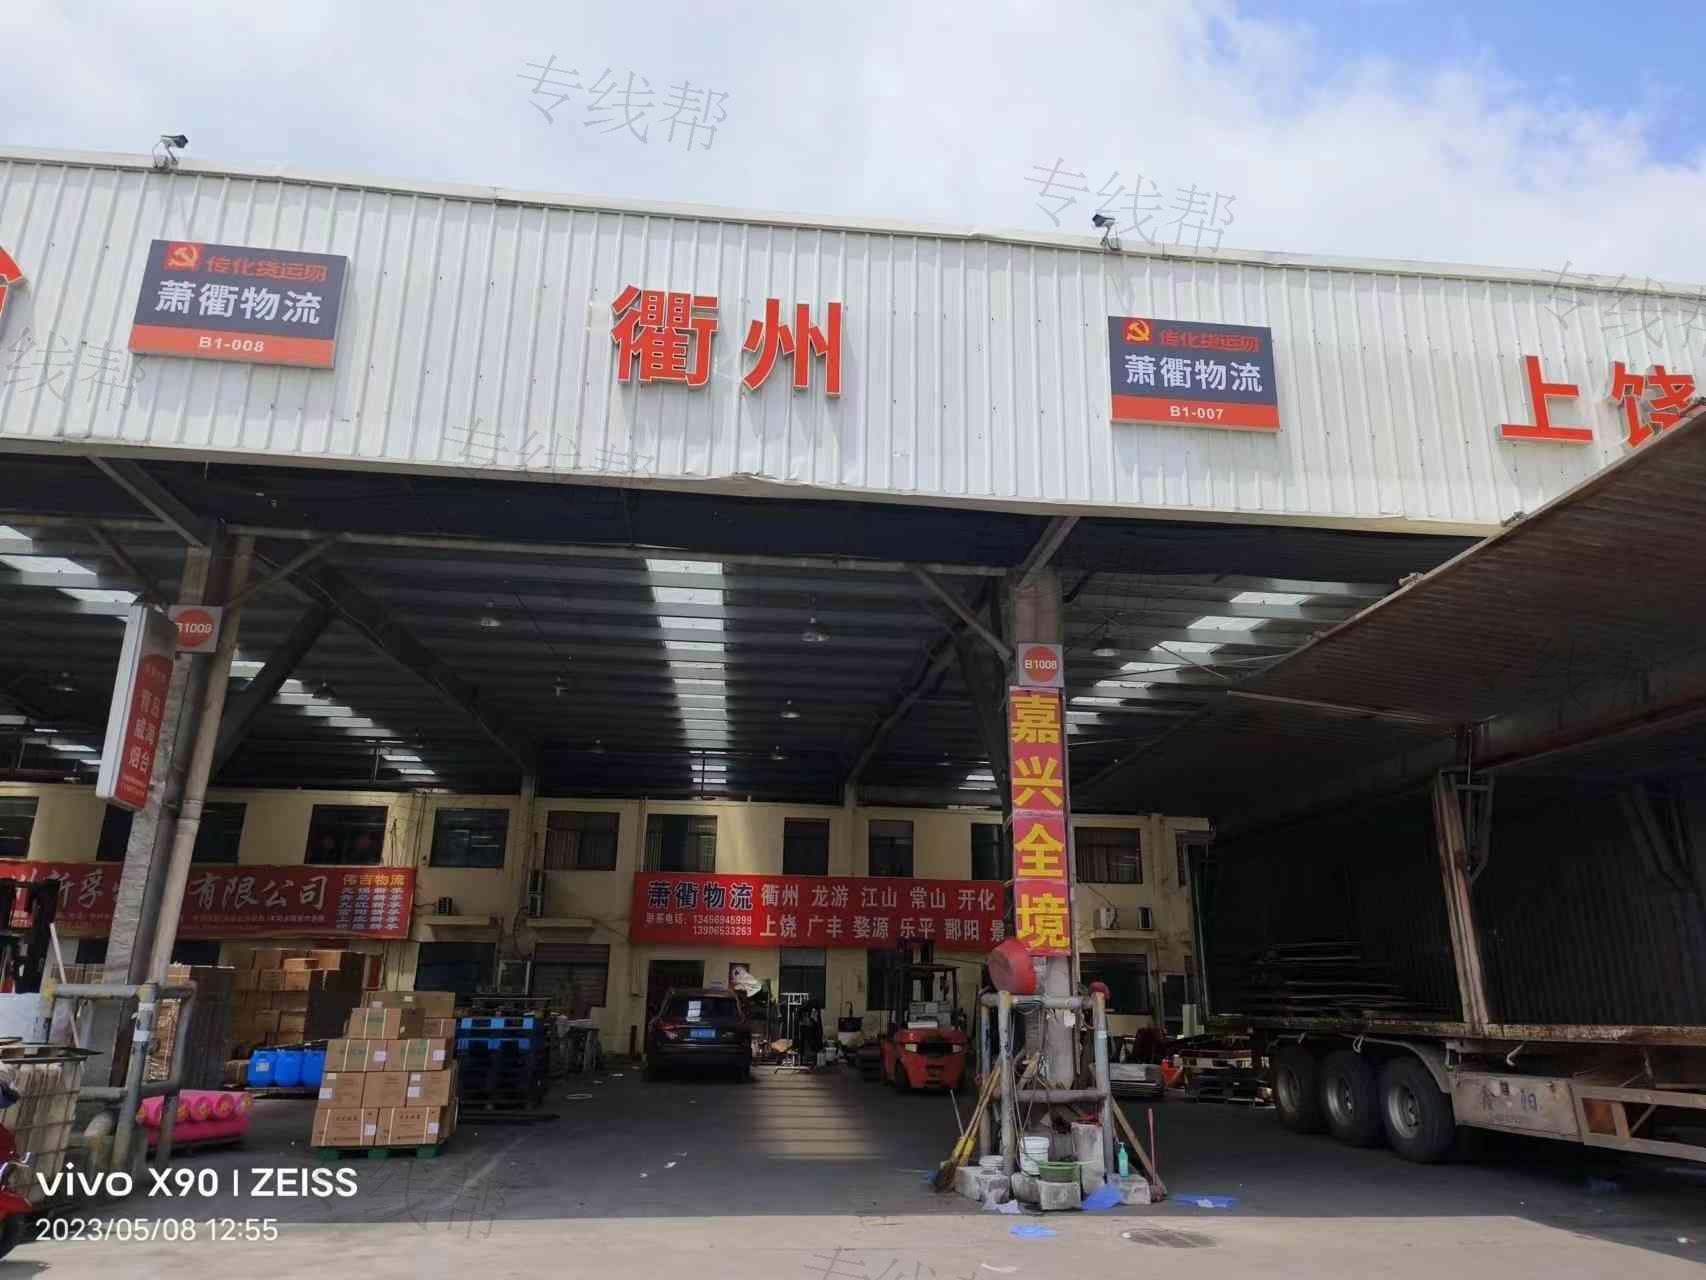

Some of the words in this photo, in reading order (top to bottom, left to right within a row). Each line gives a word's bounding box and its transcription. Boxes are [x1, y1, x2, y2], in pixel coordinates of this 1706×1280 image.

[154, 279, 323, 325] 萧衢物流
[199, 335, 265, 353] B1-008
[611, 285, 843, 398] 衢州
[1124, 354, 1264, 394] 萧衢物流
[1169, 405, 1225, 420] B1-007
[1010, 694, 1070, 950] 嘉兴全境
[647, 880, 754, 910] 萧衢物流
[760, 884, 799, 907] 衢州
[811, 884, 849, 908] 龙游
[861, 886, 898, 909] 江山
[910, 886, 946, 911] 常山
[957, 888, 996, 912] 开化
[760, 915, 798, 938] 上饶
[807, 916, 843, 938] 广丰
[900, 917, 936, 939] 乐平
[944, 918, 980, 941] 鄱阳
